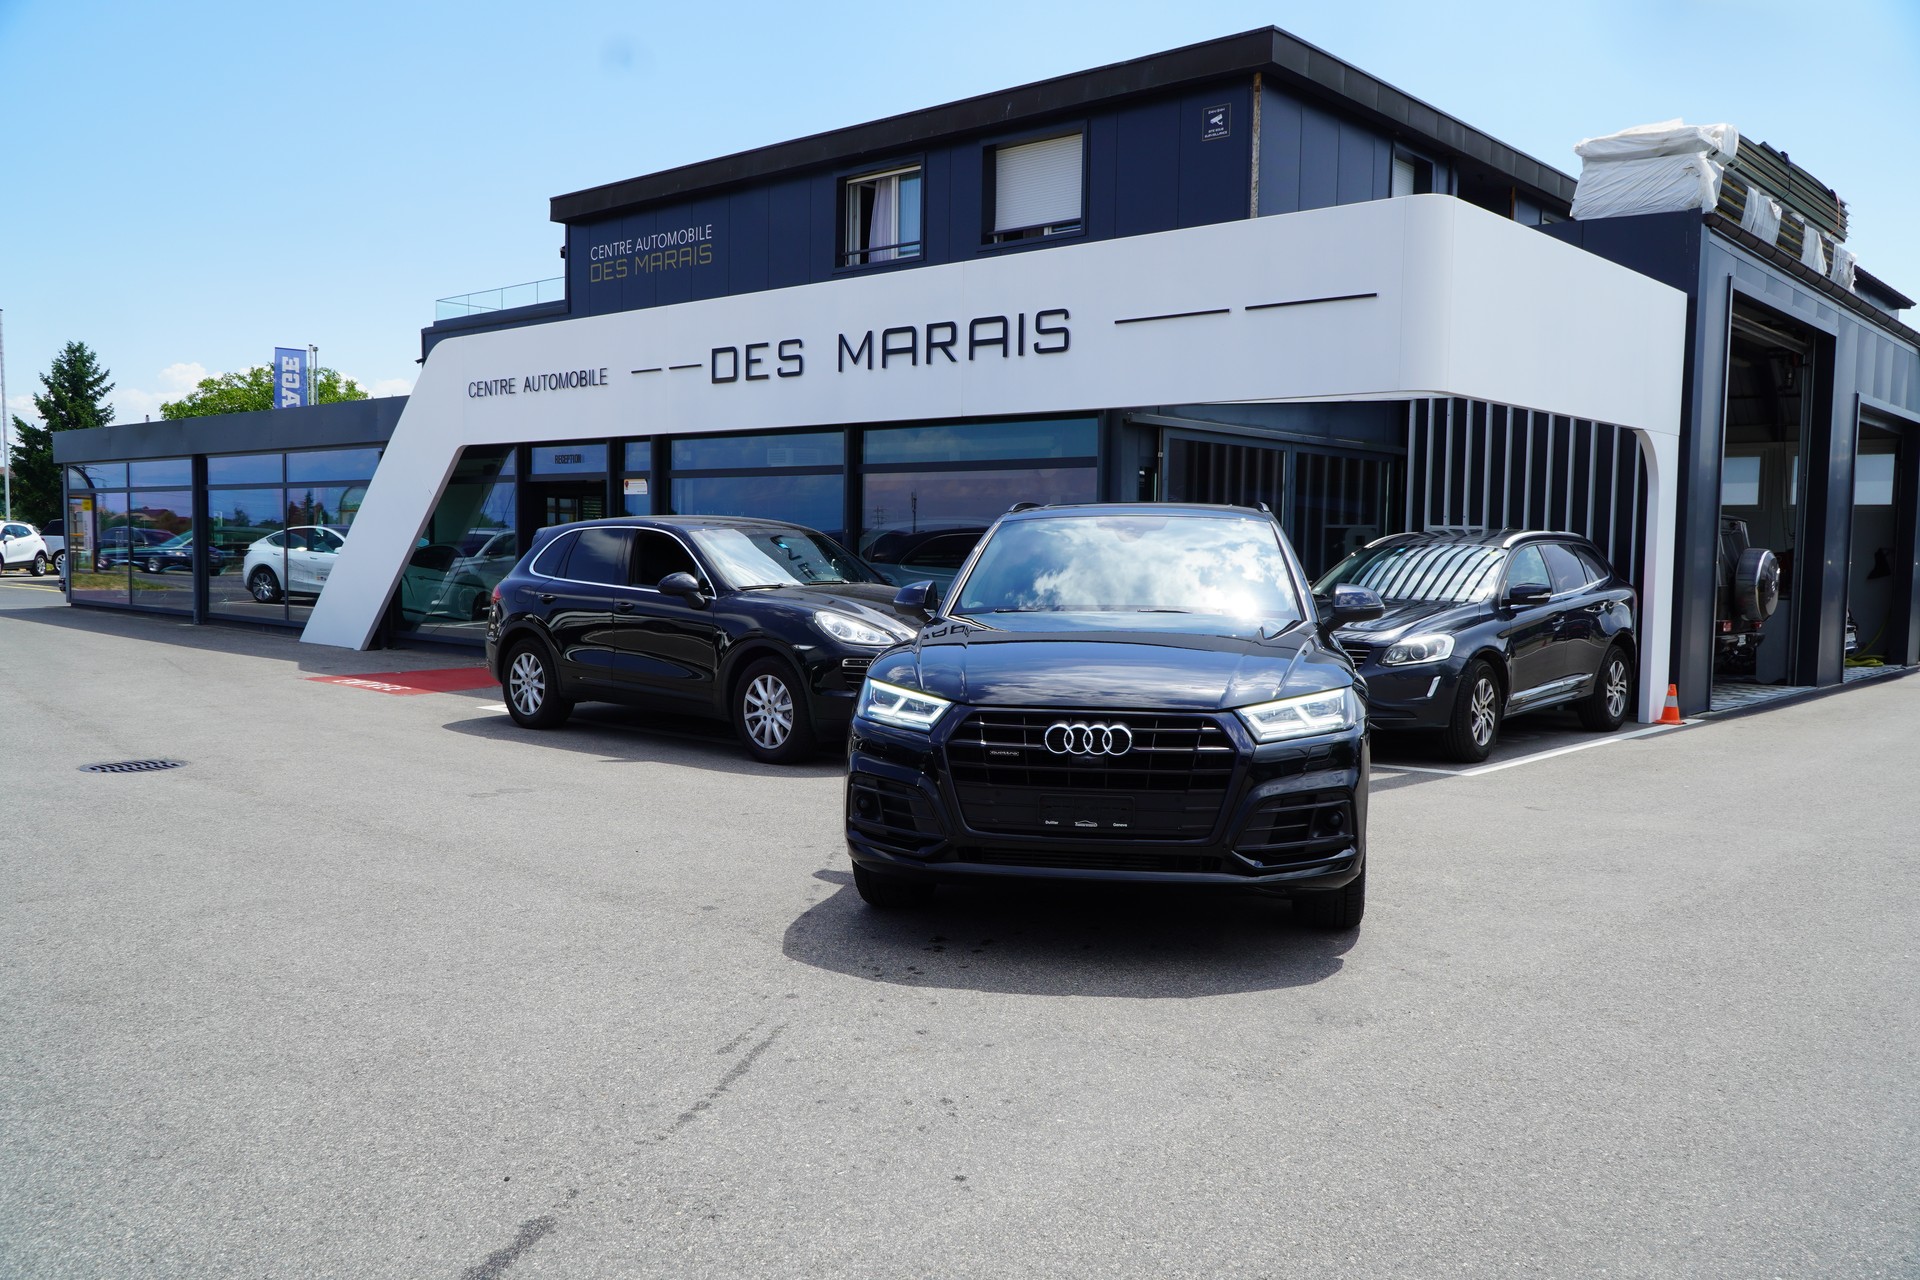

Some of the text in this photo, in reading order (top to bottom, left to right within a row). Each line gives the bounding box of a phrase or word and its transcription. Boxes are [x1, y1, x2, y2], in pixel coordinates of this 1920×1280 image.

[590, 224, 712, 260] CENTRE AUTOMOBILE
[590, 243, 712, 283] DES MARAIS
[468, 308, 1071, 398] CENTRE AUTOMOBILE DES MARAIS
